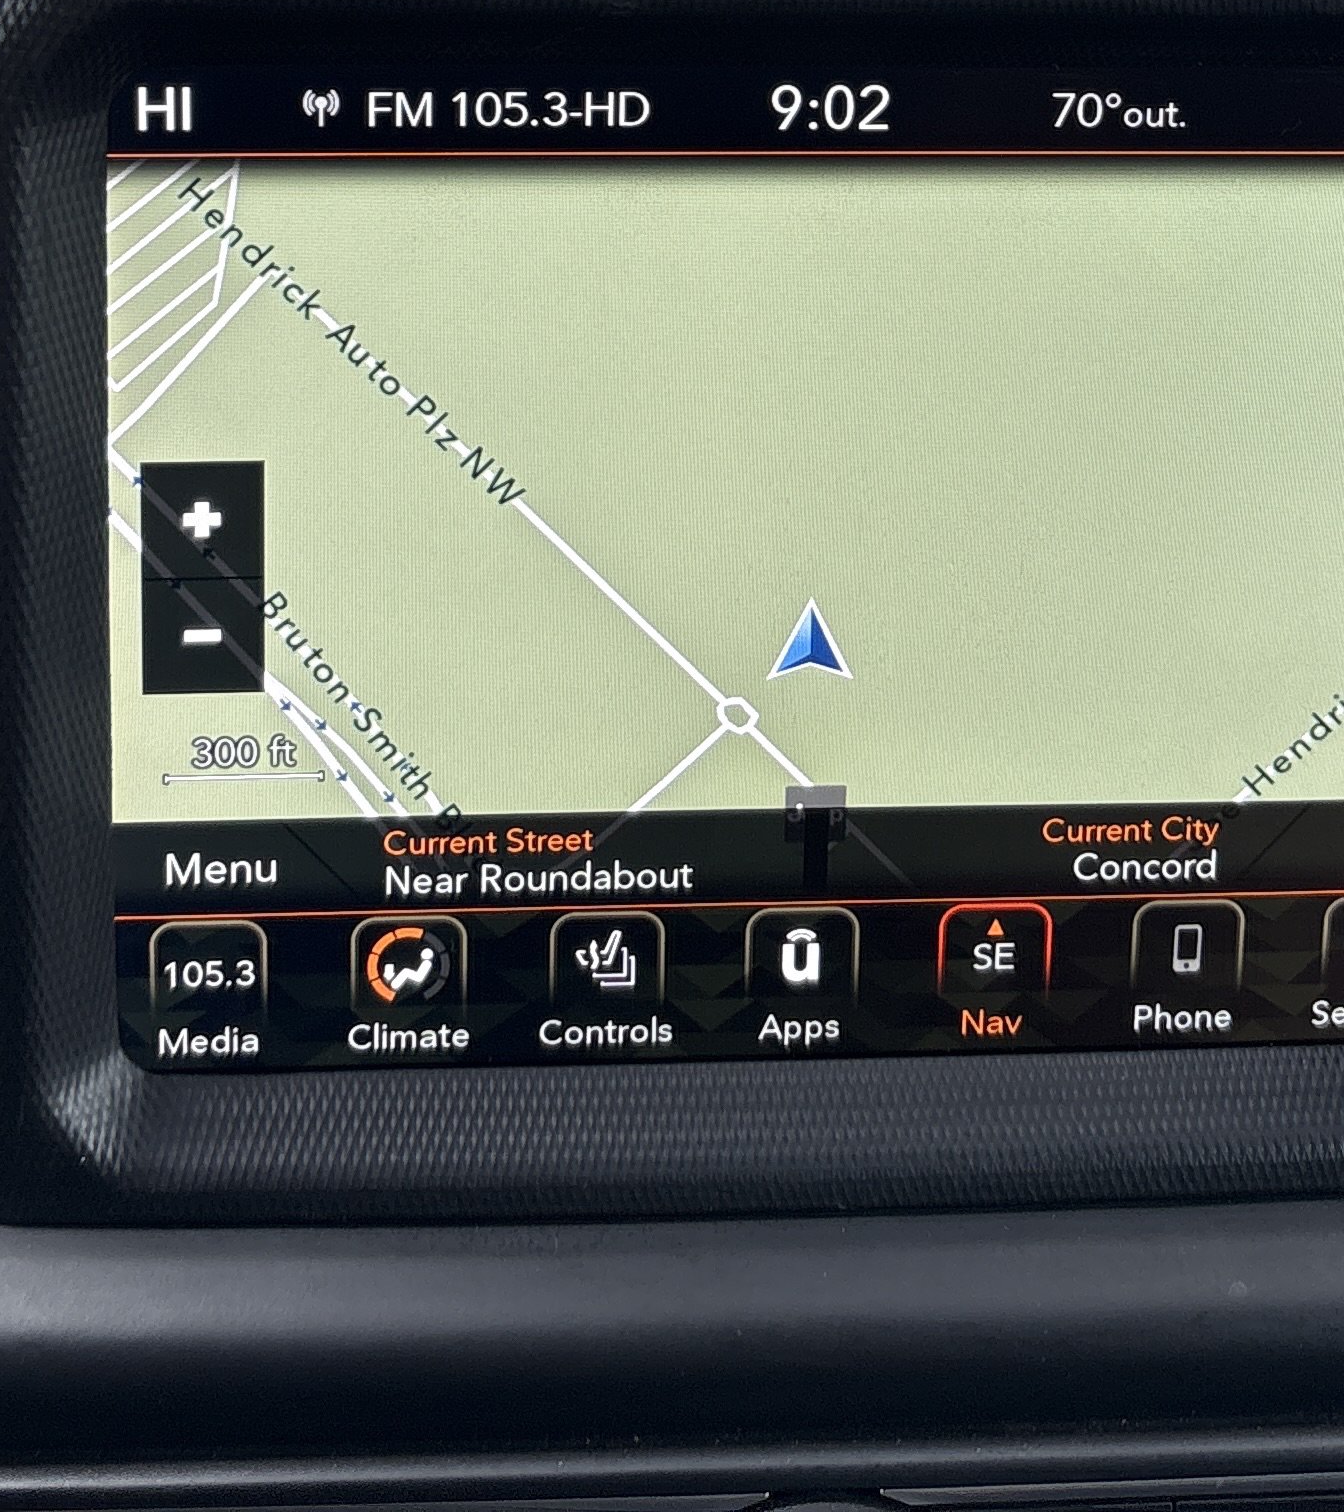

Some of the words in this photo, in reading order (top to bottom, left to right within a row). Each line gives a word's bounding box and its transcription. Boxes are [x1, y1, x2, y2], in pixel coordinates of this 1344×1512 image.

[137, 86, 192, 132] HI
[368, 91, 433, 128] FM
[452, 91, 650, 127] 105.3-HD
[771, 84, 890, 131] 9:02
[177, 177, 322, 322] Hendrick
[325, 322, 402, 397] Auto
[407, 395, 458, 452] Plz
[459, 446, 526, 507] NW
[260, 591, 350, 706] Bruton
[353, 706, 431, 801] Smith
[190, 737, 264, 769] 300
[267, 734, 297, 768] ft
[383, 830, 498, 856] Current
[506, 827, 594, 853] Street
[1042, 817, 1153, 843] Current
[1161, 815, 1220, 846] City
[164, 852, 278, 886] Menu
[385, 865, 469, 896] Near
[480, 859, 694, 894] Roundabout
[1073, 848, 1217, 881] Concord
[972, 942, 1015, 971] SE
[163, 958, 256, 990] 105.3
[539, 1015, 673, 1046] Controls
[757, 1013, 840, 1049] Apps
[961, 1008, 1023, 1036] Nav
[1133, 1002, 1232, 1031] Phone
[158, 1025, 259, 1057] Media
[347, 1022, 470, 1051] Climate
